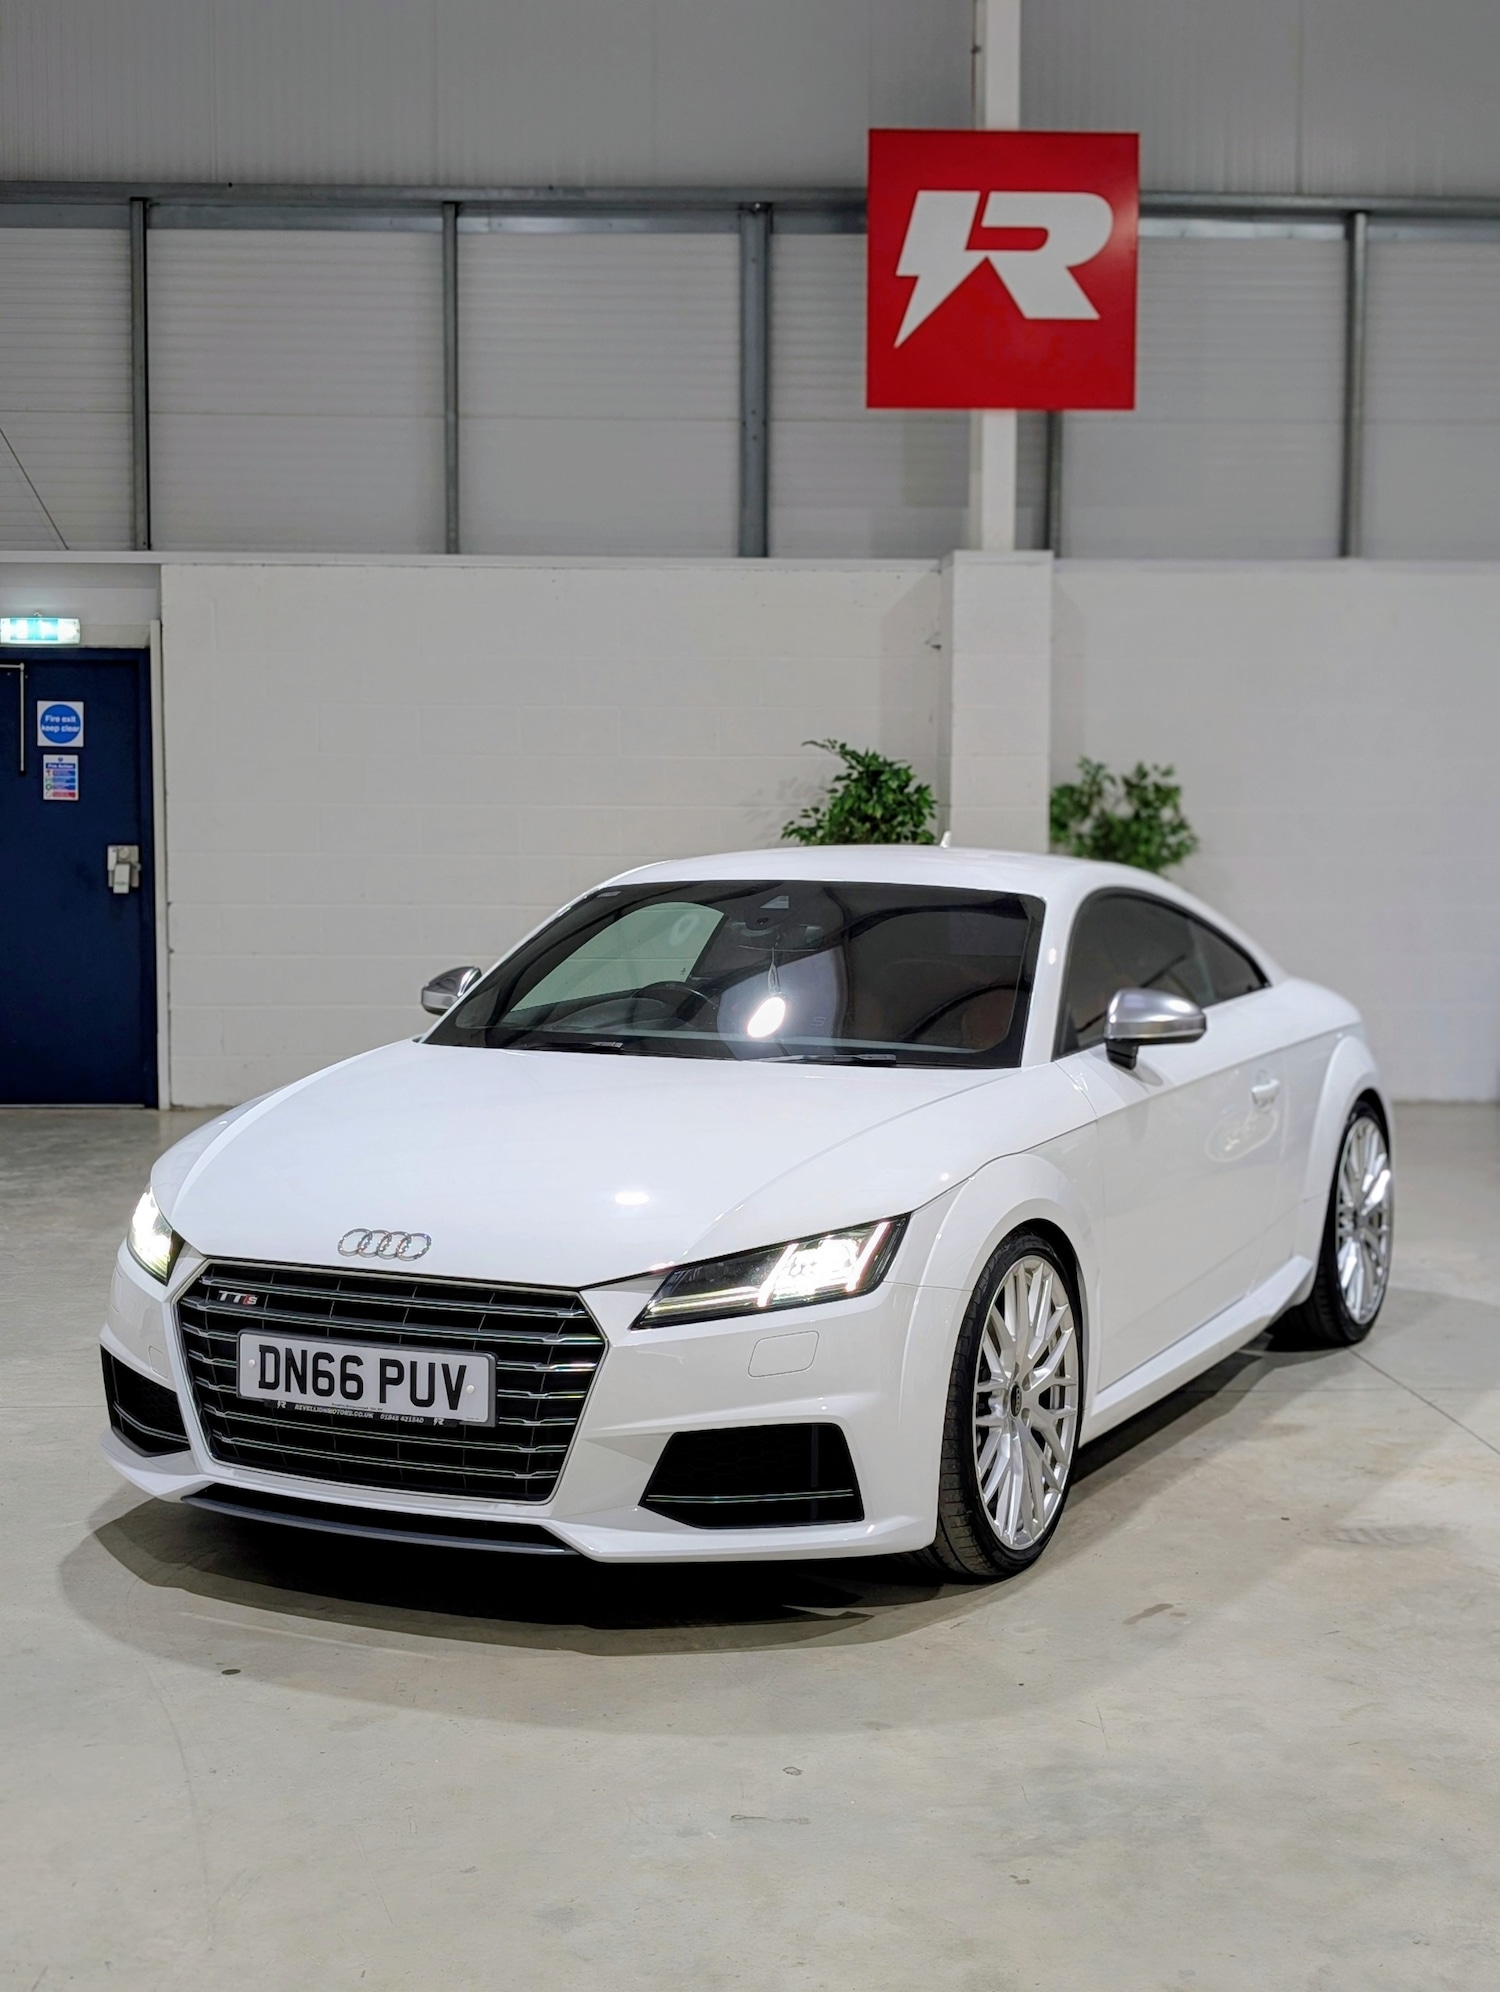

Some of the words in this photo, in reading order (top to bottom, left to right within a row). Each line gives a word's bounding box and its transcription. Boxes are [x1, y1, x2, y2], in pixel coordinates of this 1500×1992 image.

[41, 725, 60, 733] keep
[218, 1290, 258, 1306] TTS
[258, 1344, 364, 1401] DN66
[379, 1357, 467, 1411] PUV
